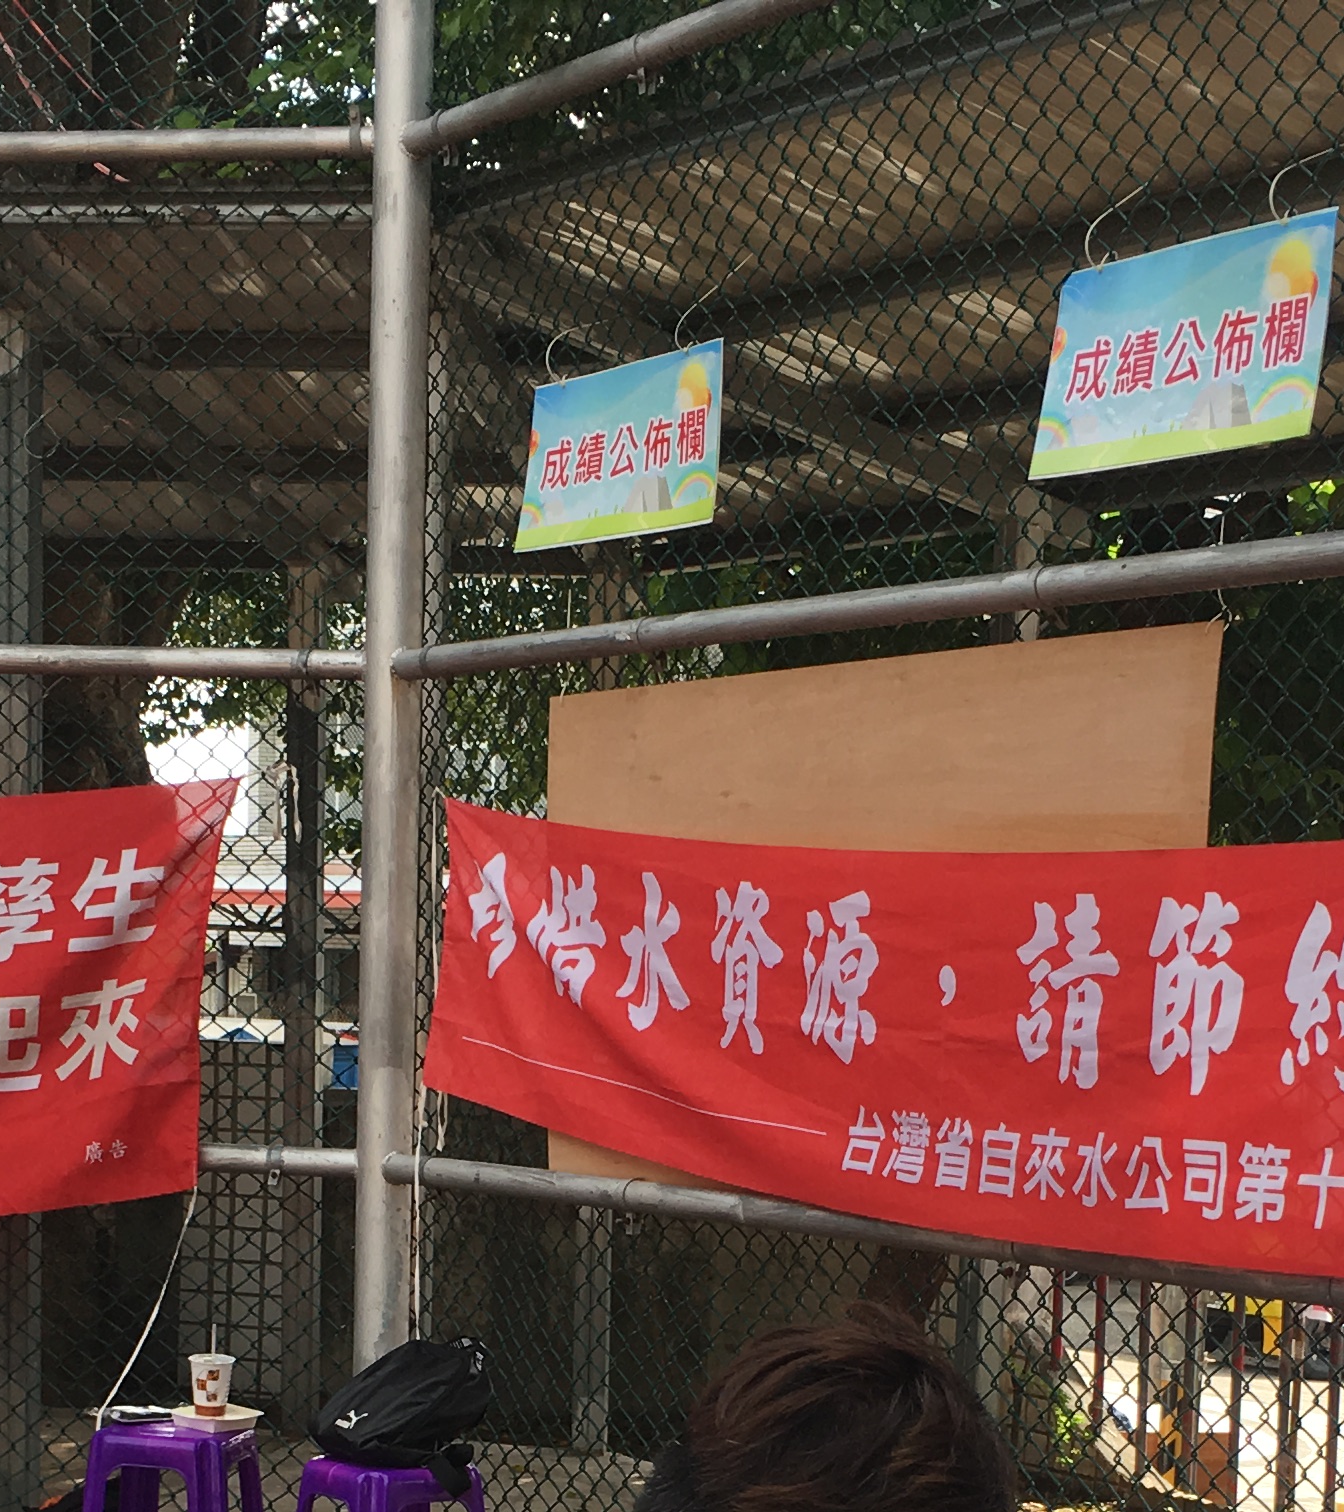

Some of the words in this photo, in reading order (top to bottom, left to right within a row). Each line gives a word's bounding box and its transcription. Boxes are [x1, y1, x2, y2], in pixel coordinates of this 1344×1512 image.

[1065, 293, 1310, 404] 成績公佈欄
[539, 407, 709, 493] 成績公佈欄
[83, 1138, 128, 1164] 廣告
